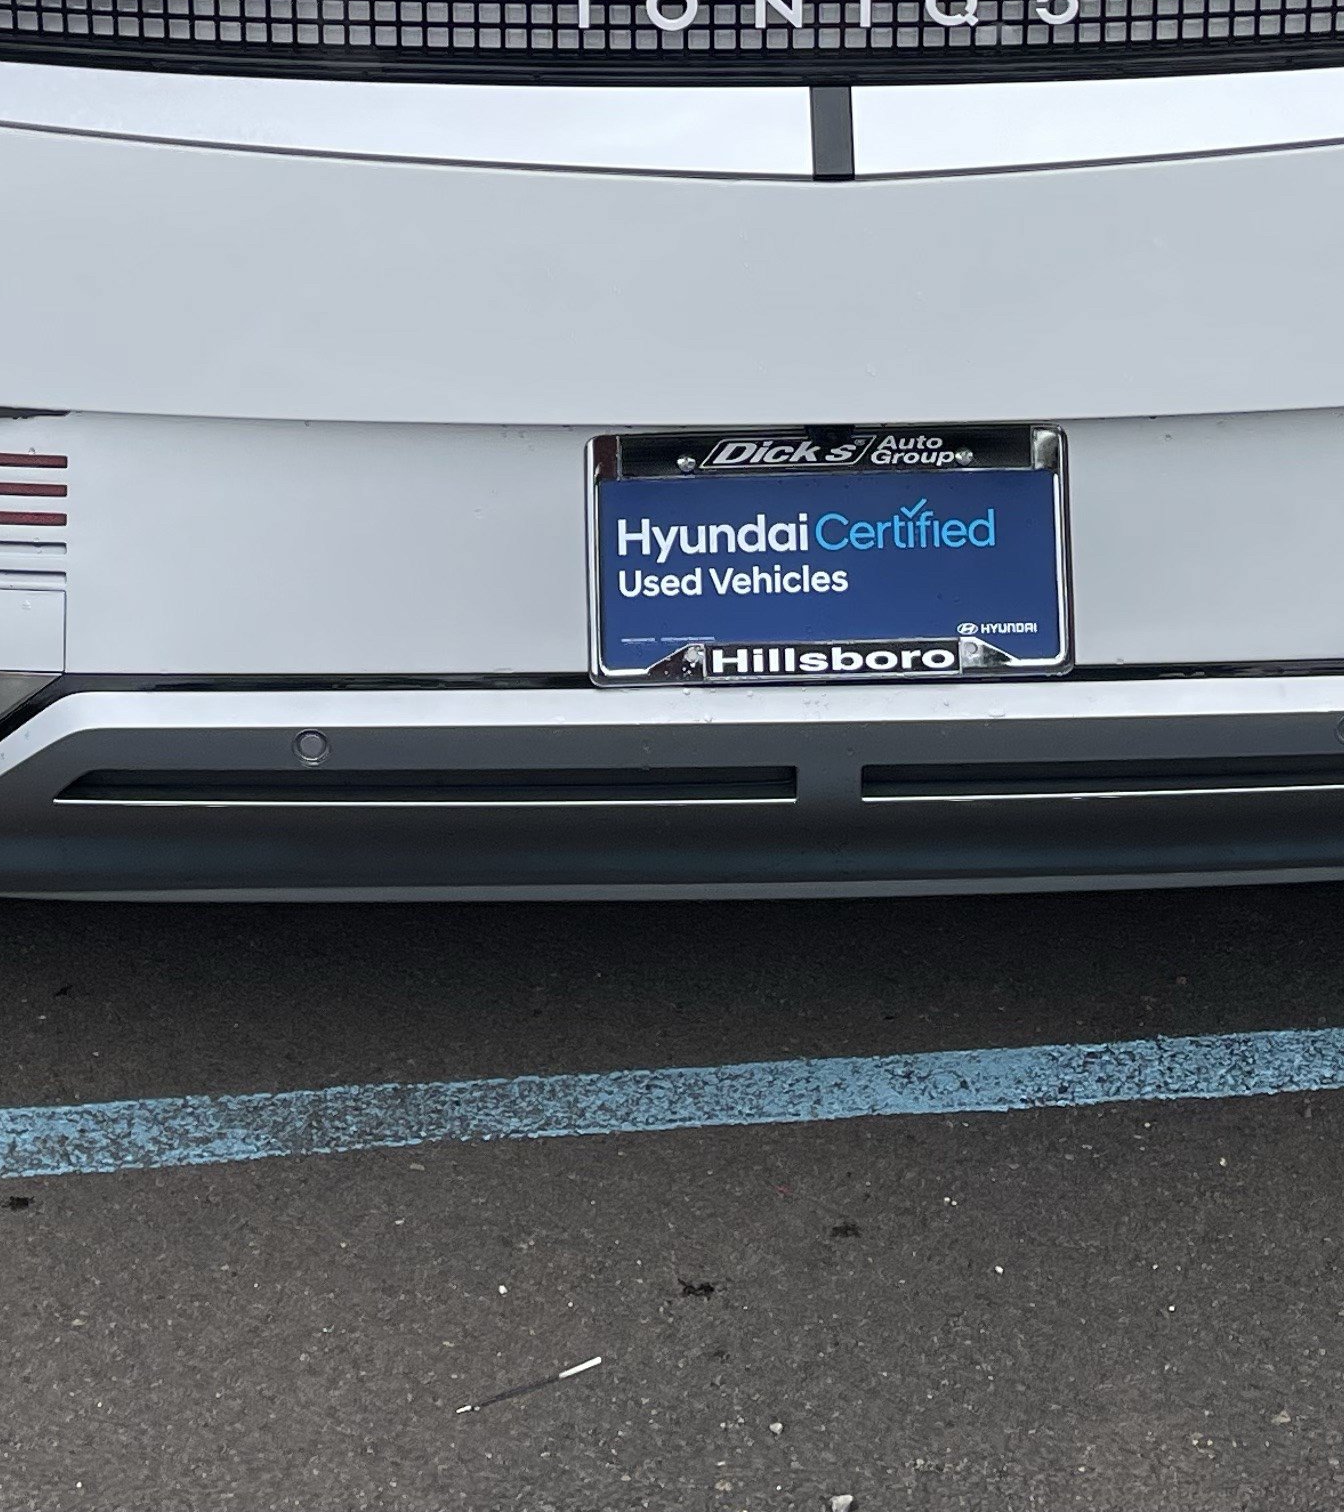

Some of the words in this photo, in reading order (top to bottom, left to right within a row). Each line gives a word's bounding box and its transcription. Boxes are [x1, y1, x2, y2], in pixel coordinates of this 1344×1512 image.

[877, 434, 943, 451] Auto
[870, 449, 955, 466] Group
[617, 513, 809, 563] Hyundai
[814, 498, 996, 551] Certified
[617, 568, 703, 598] Used
[709, 565, 849, 595] Vehicles
[980, 622, 1038, 634] HYUNDAI
[712, 647, 955, 674] Hillsboro
